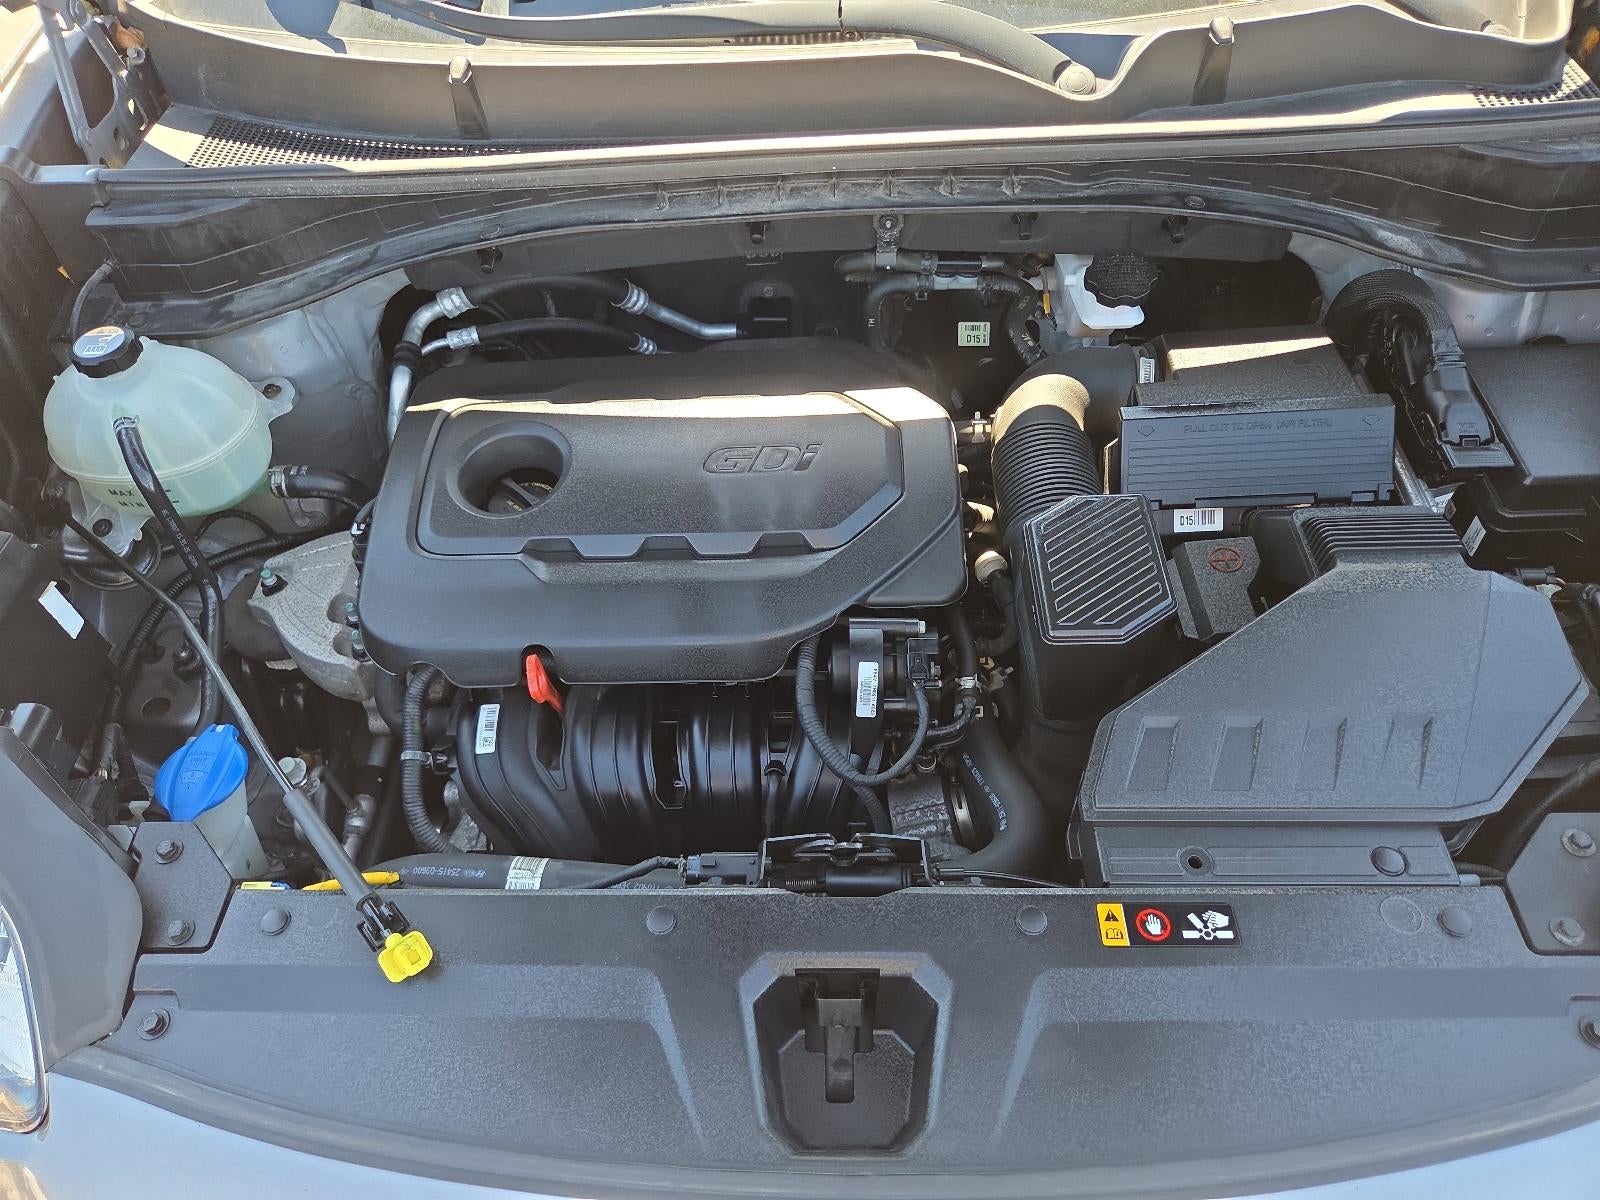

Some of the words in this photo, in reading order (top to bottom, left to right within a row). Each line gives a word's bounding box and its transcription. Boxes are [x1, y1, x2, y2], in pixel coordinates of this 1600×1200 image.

[1183, 424, 1207, 433] PULL
[1210, 423, 1230, 432] OUT
[1232, 422, 1243, 431] TO
[1246, 421, 1273, 430] OPEN
